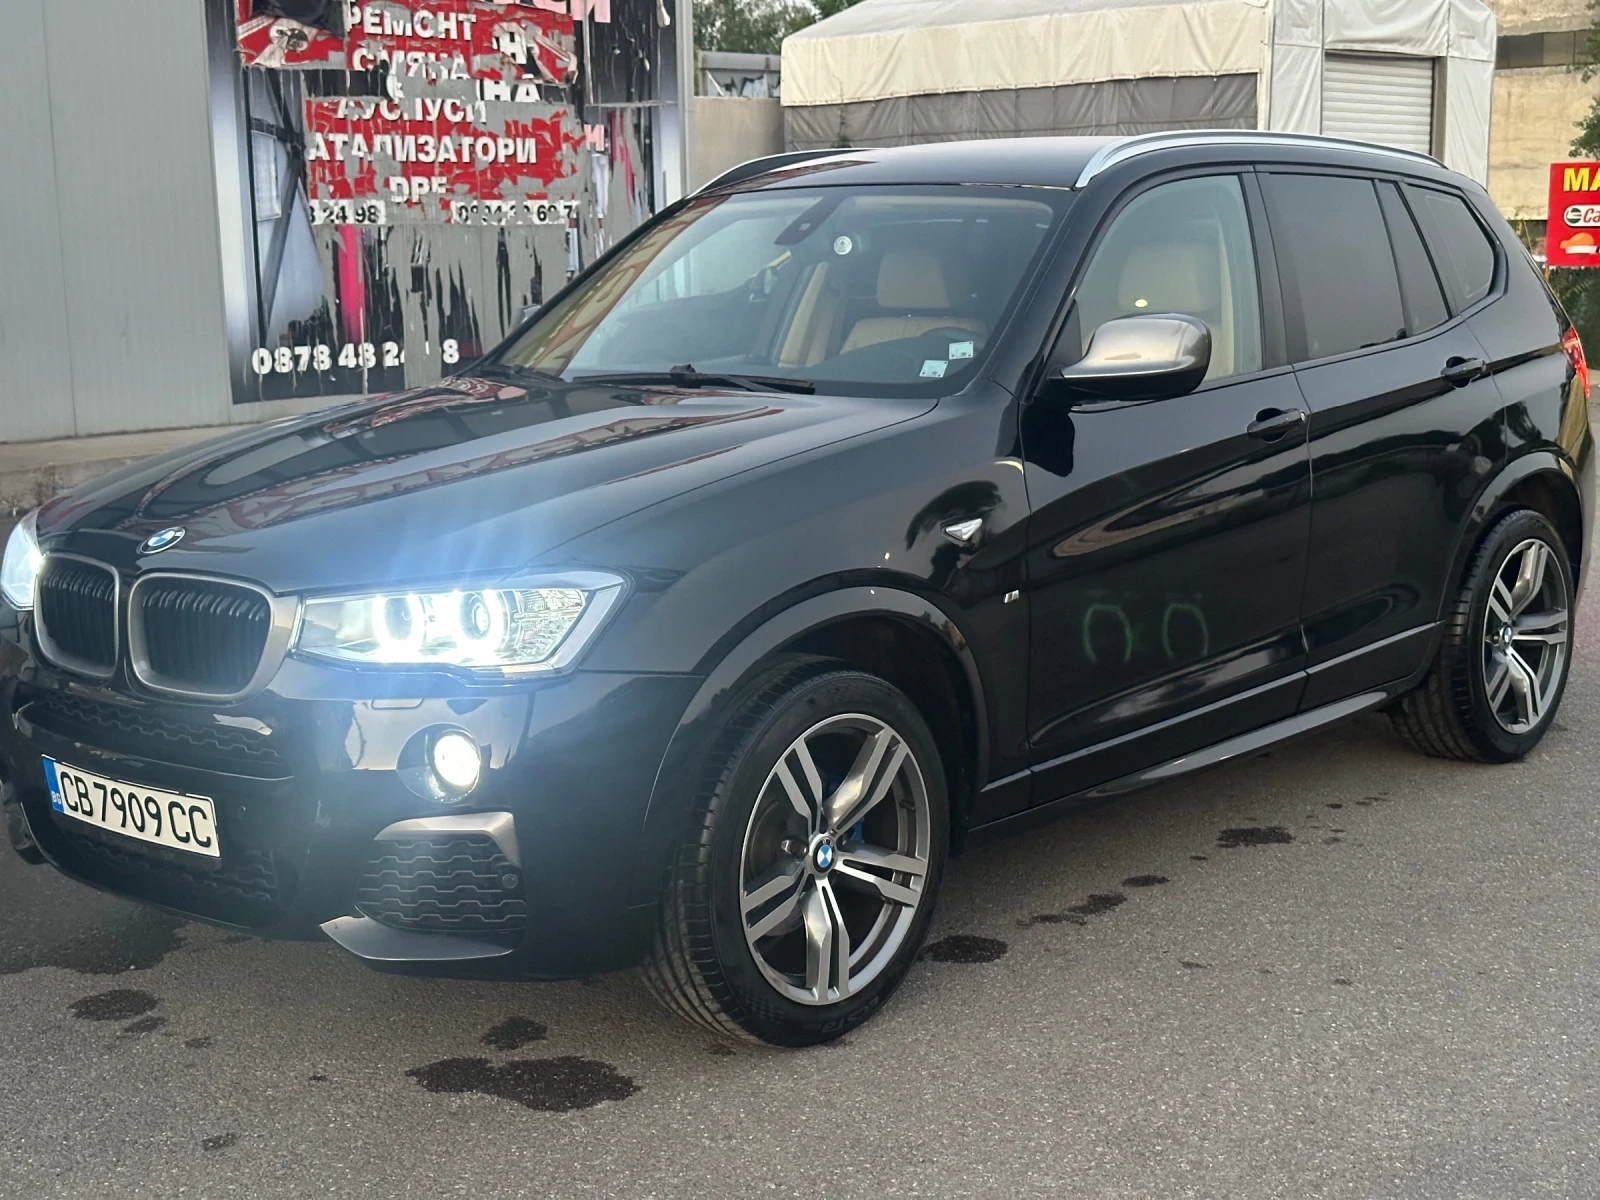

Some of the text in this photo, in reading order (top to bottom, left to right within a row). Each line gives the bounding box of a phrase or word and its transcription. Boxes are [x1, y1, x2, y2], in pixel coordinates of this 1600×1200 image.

[355, 205, 380, 223] 98
[251, 343, 332, 375] 0878
[338, 341, 377, 369] 48
[382, 340, 404, 368] 2
